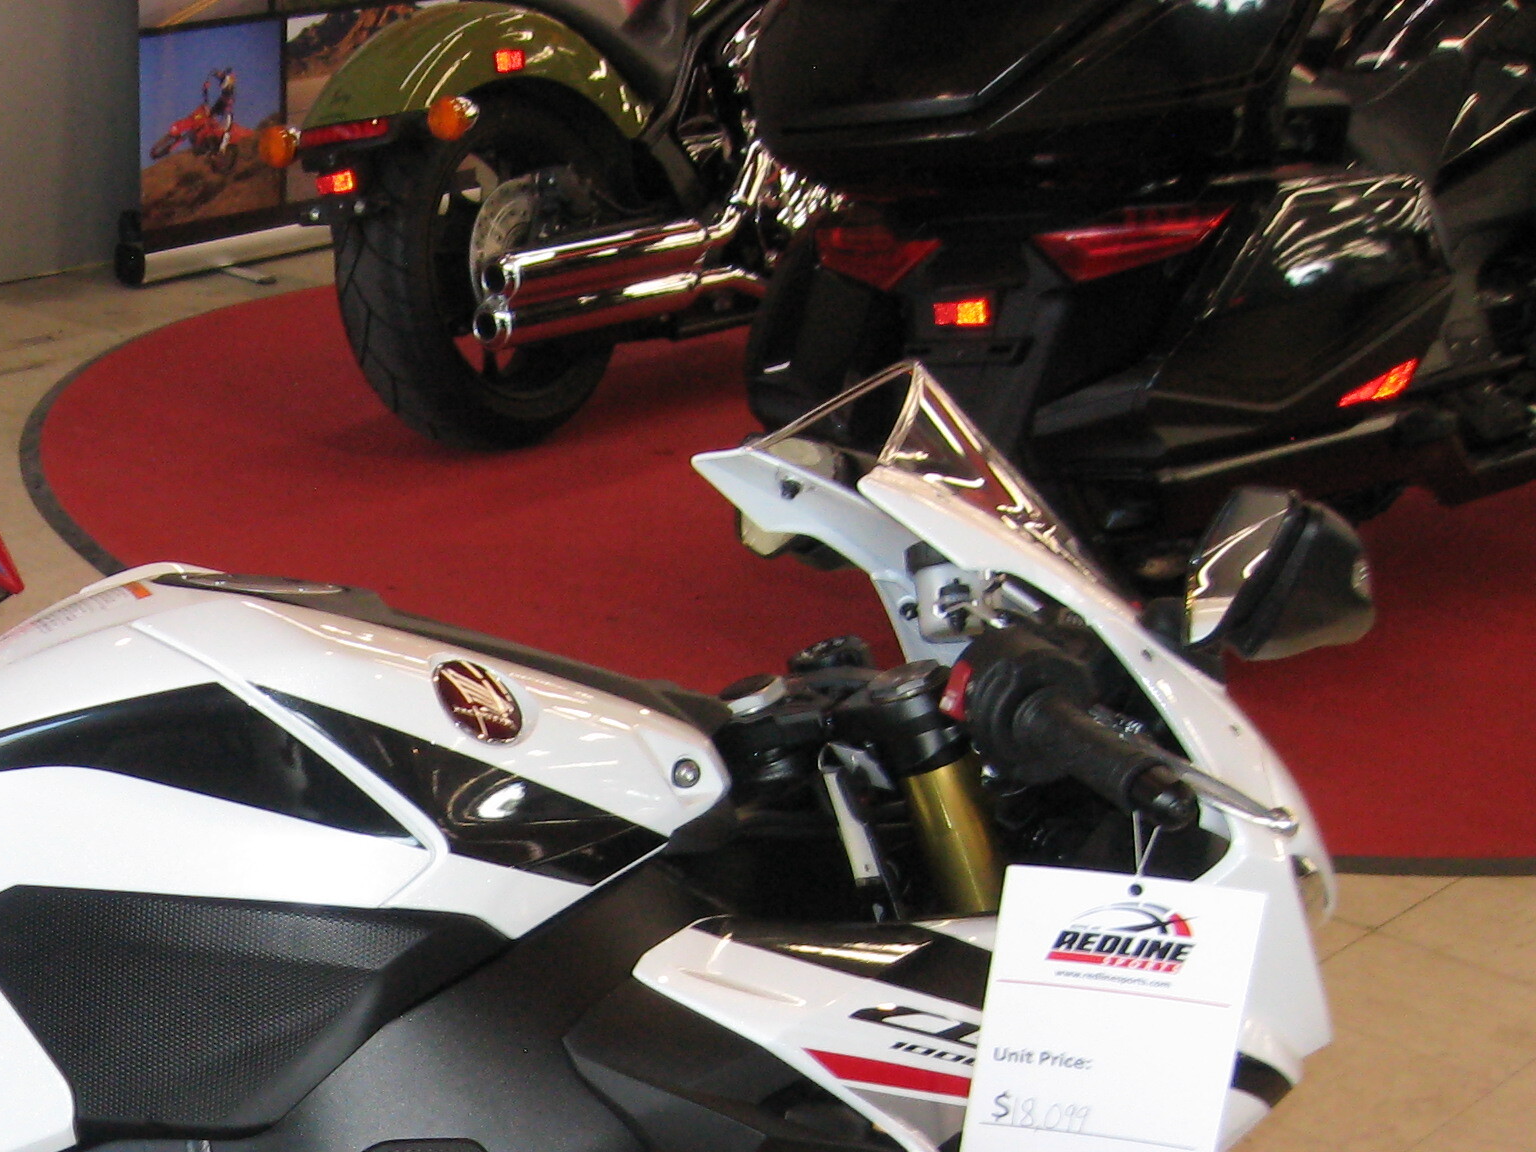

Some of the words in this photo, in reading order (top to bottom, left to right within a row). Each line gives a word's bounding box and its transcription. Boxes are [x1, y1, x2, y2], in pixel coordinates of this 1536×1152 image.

[1052, 930, 1196, 962] REDLINE
[993, 1047, 1034, 1065] Unit
[1038, 1051, 1094, 1070] Price:
